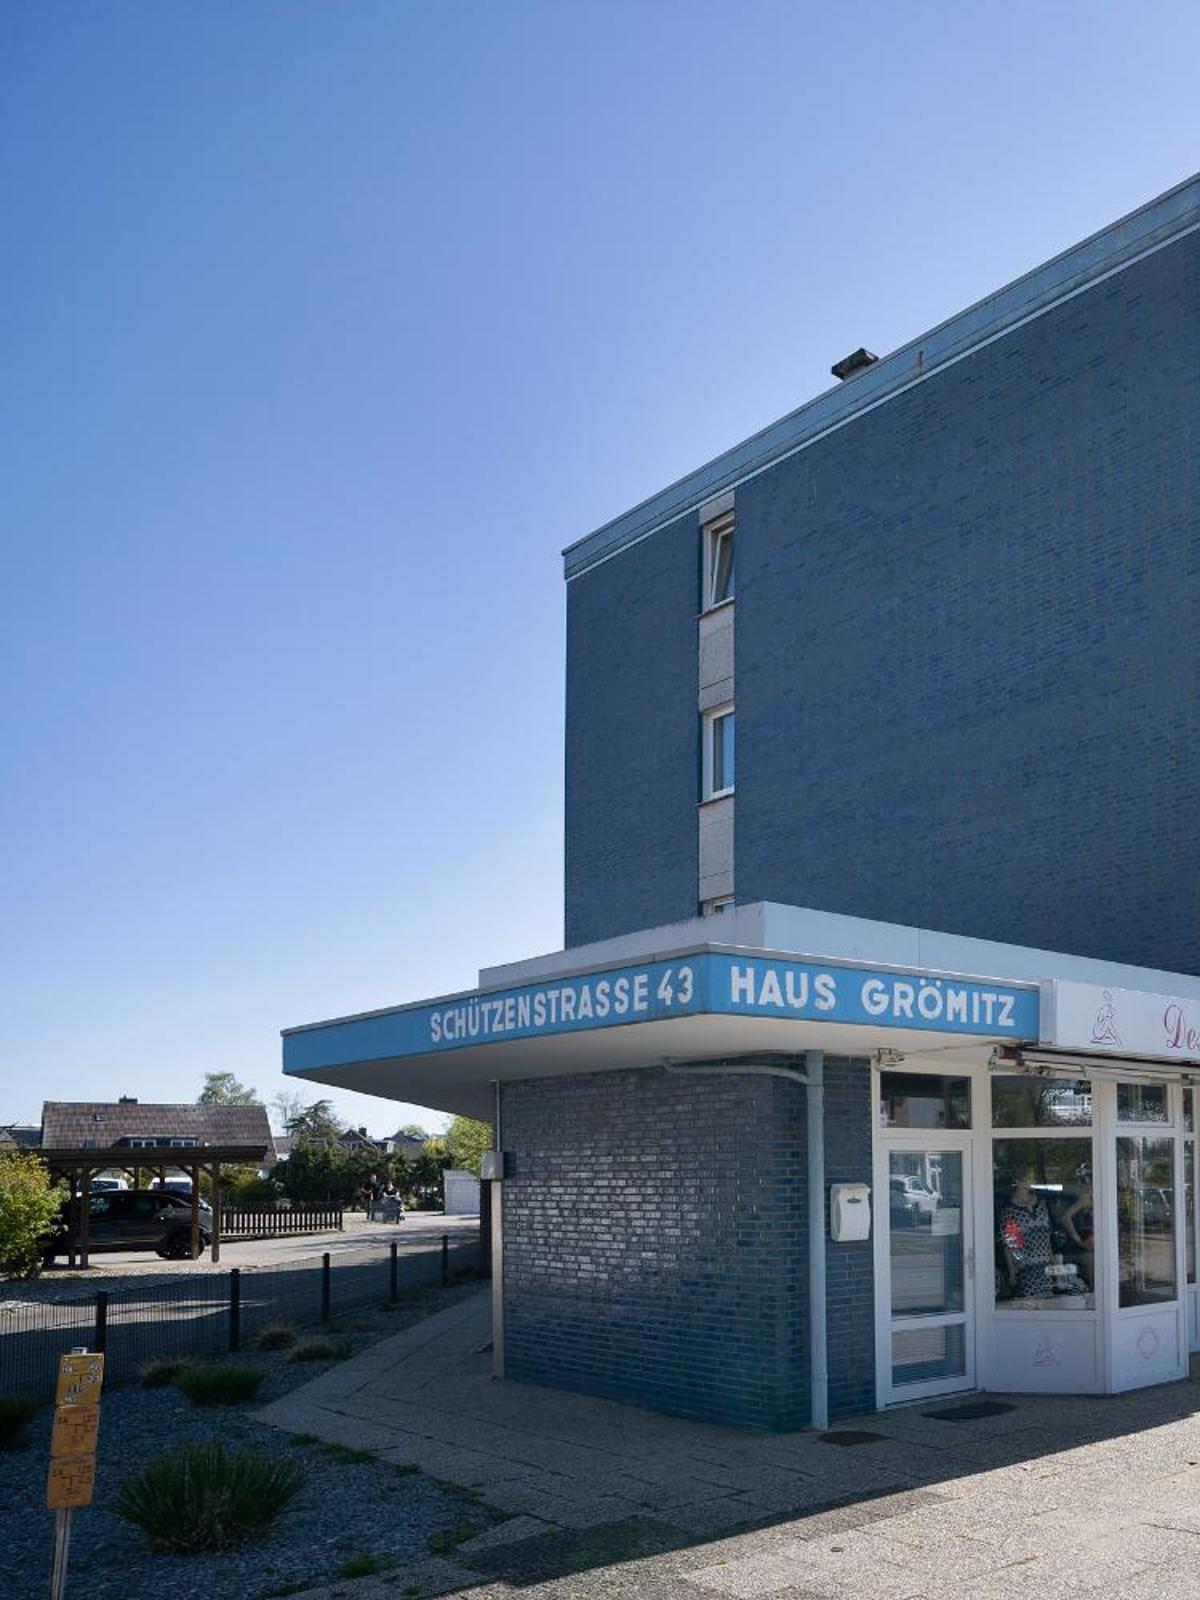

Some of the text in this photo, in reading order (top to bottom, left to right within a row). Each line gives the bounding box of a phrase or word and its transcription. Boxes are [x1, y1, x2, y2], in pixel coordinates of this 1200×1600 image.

[429, 966, 694, 1044] SCHÜTZENSTRASSE 43
[730, 966, 1016, 1028] HAUS GRÖMITZ
